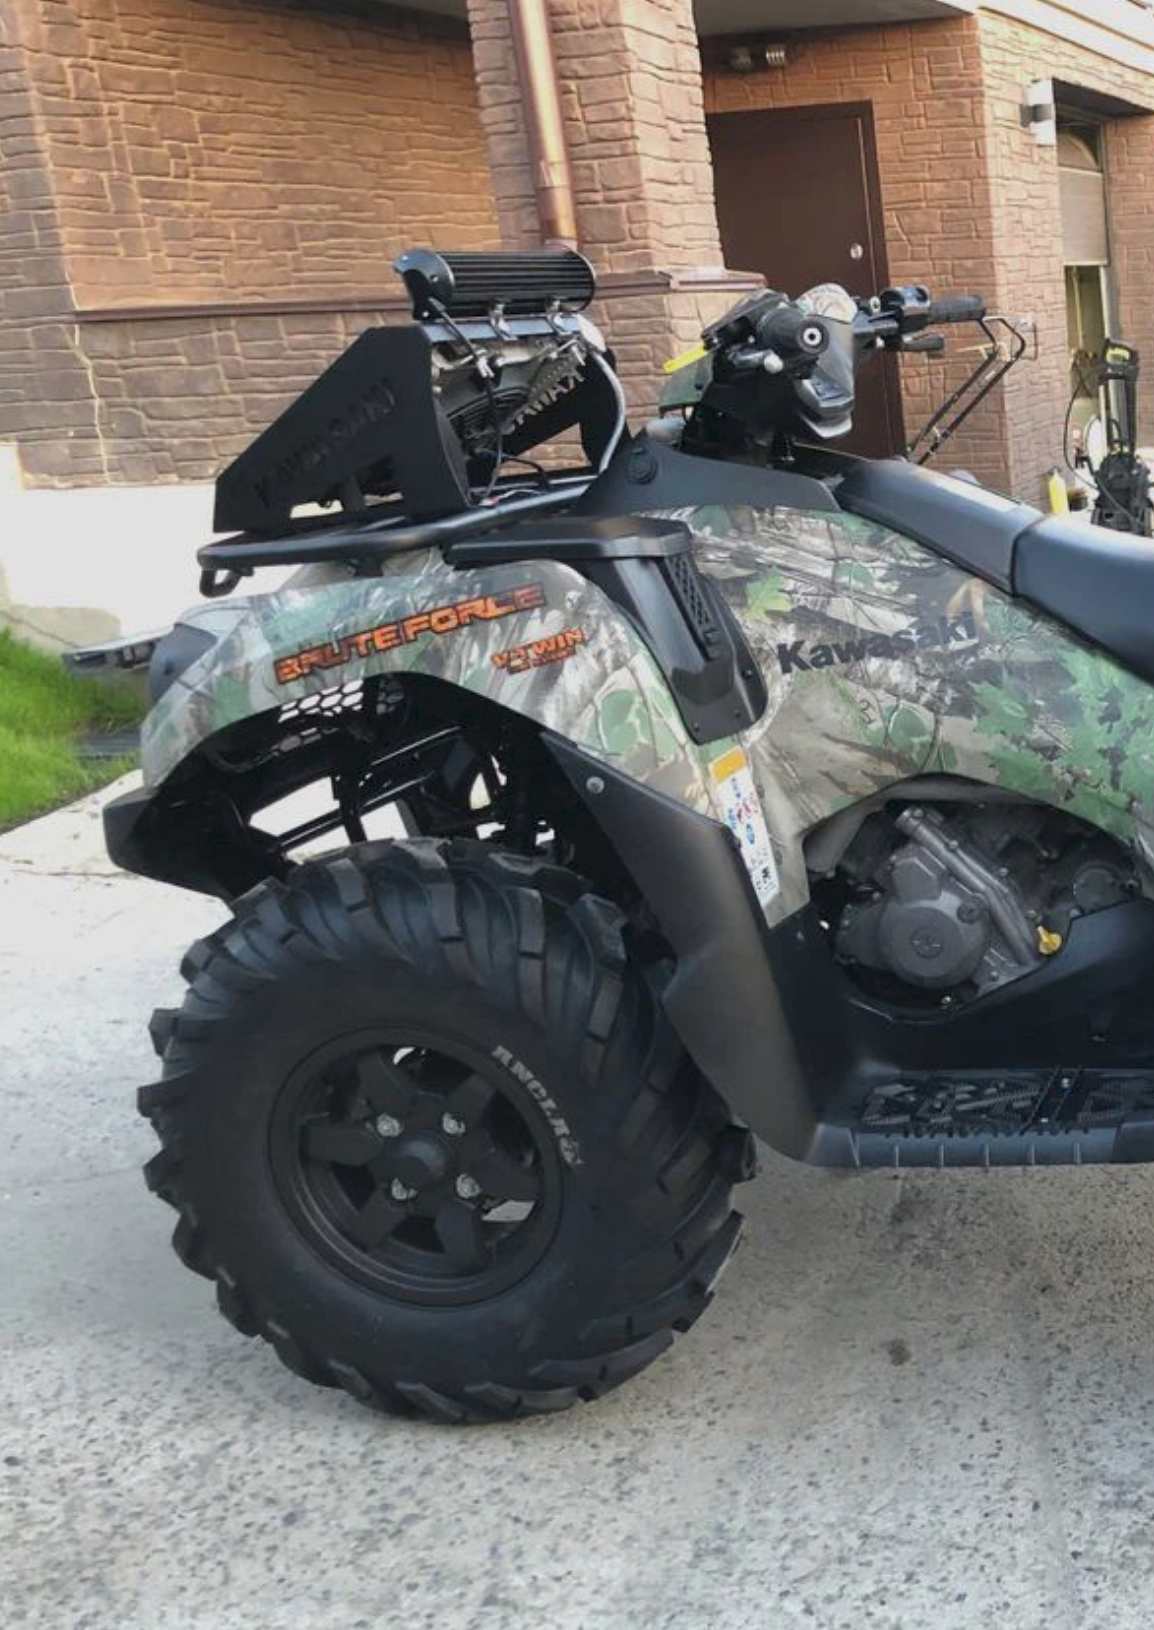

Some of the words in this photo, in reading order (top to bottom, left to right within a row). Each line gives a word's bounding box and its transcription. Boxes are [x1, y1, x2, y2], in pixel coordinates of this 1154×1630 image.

[273, 626, 402, 685] BRUTE
[776, 610, 979, 674] Kawasaki
[492, 1044, 571, 1137] ANCLA
